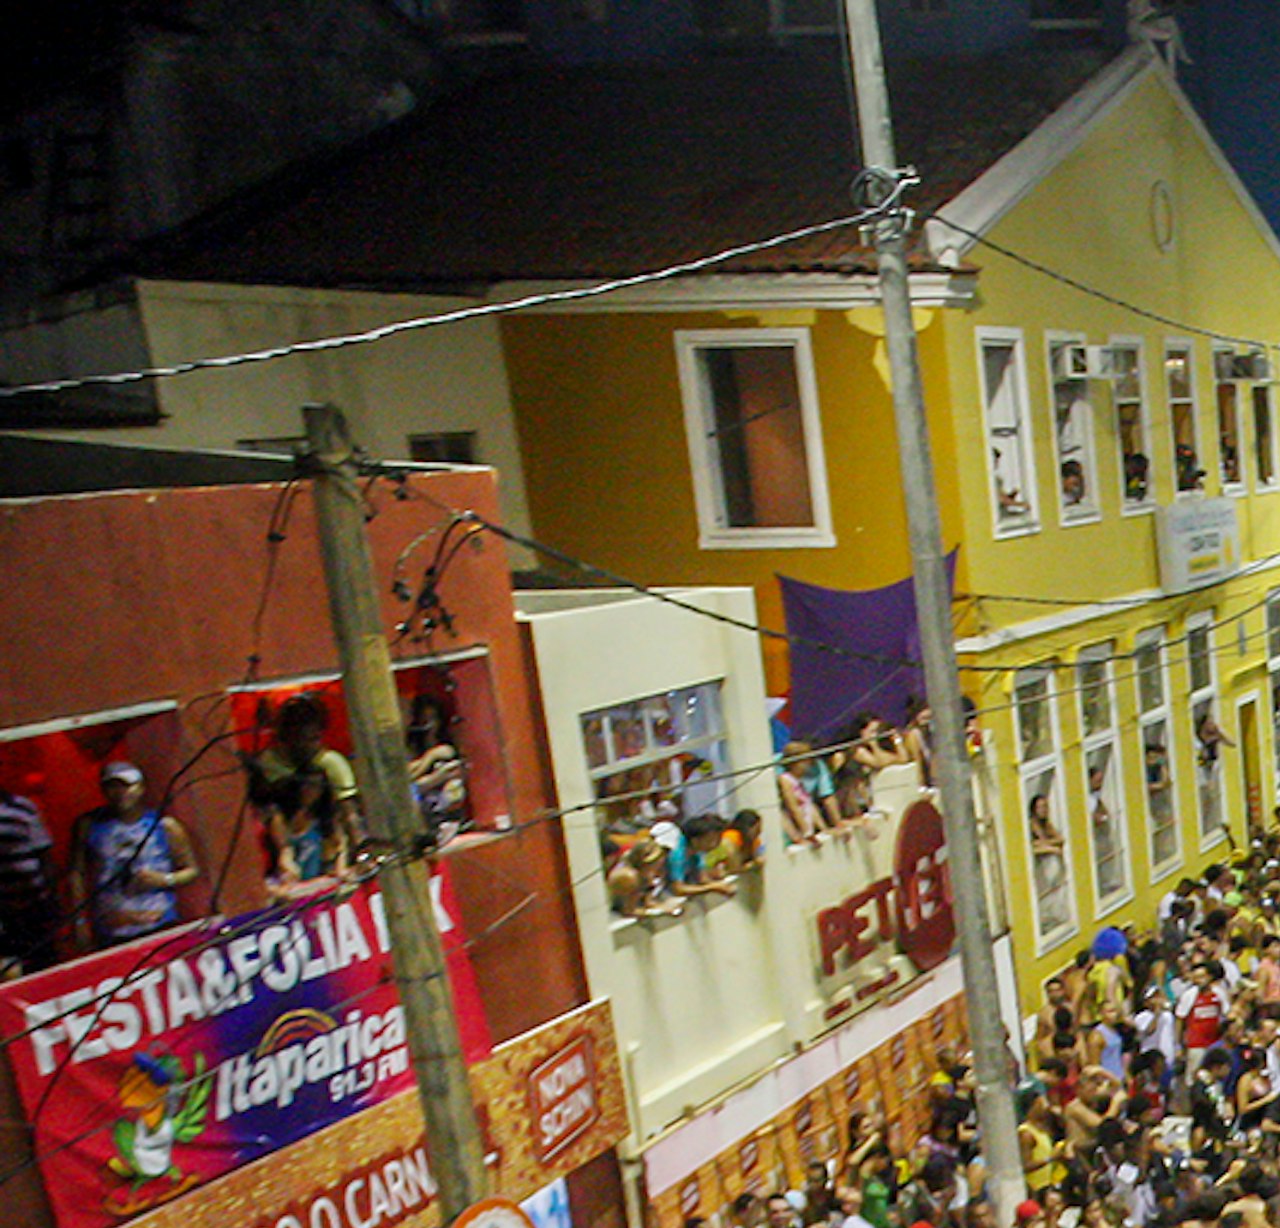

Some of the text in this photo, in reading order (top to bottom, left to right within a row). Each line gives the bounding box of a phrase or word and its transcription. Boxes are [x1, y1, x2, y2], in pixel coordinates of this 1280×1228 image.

[25, 903, 370, 1077] FESTA&FOLIA
[216, 1005, 406, 1120] Itaparica
[328, 1066, 377, 1103] 91.3
